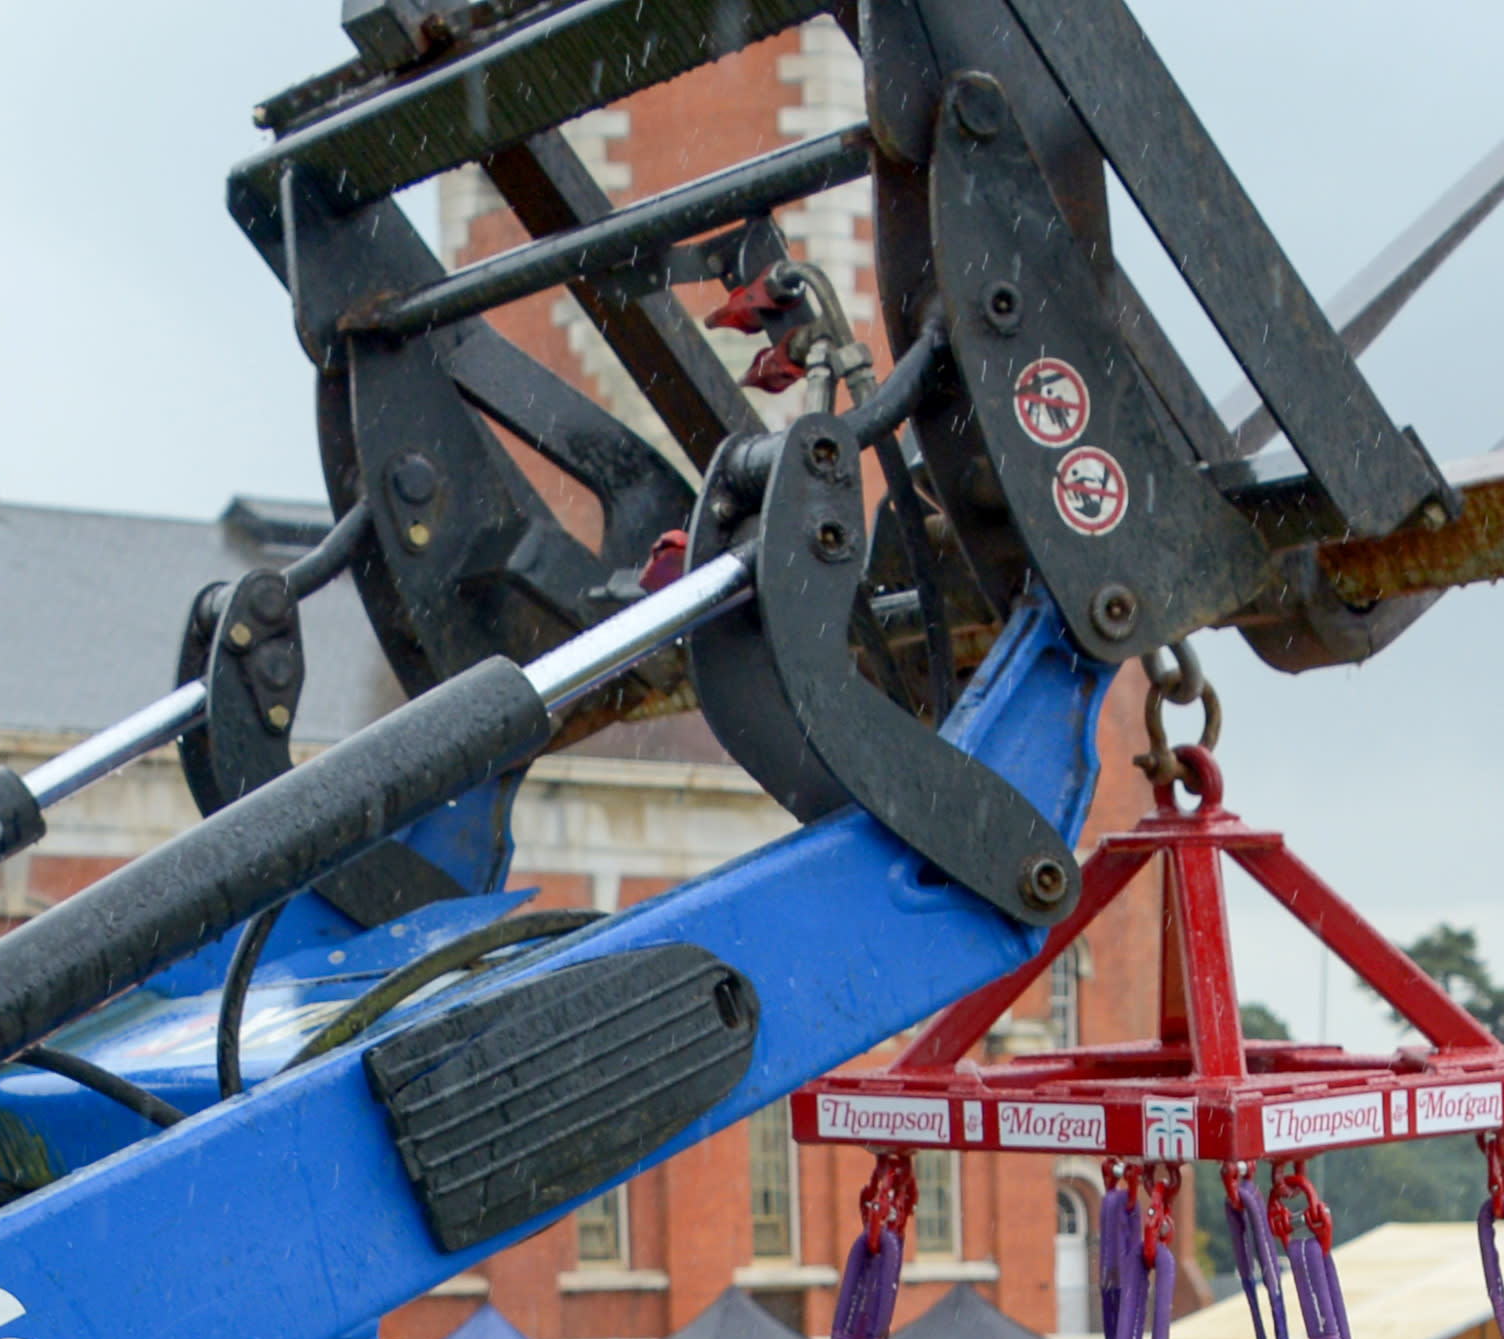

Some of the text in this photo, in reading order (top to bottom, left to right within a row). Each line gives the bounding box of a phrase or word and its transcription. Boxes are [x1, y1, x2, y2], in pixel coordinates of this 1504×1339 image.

[822, 1099, 1104, 1148] Thompson & Morgan
[1265, 1091, 1502, 1142] Thompson & Morgan
